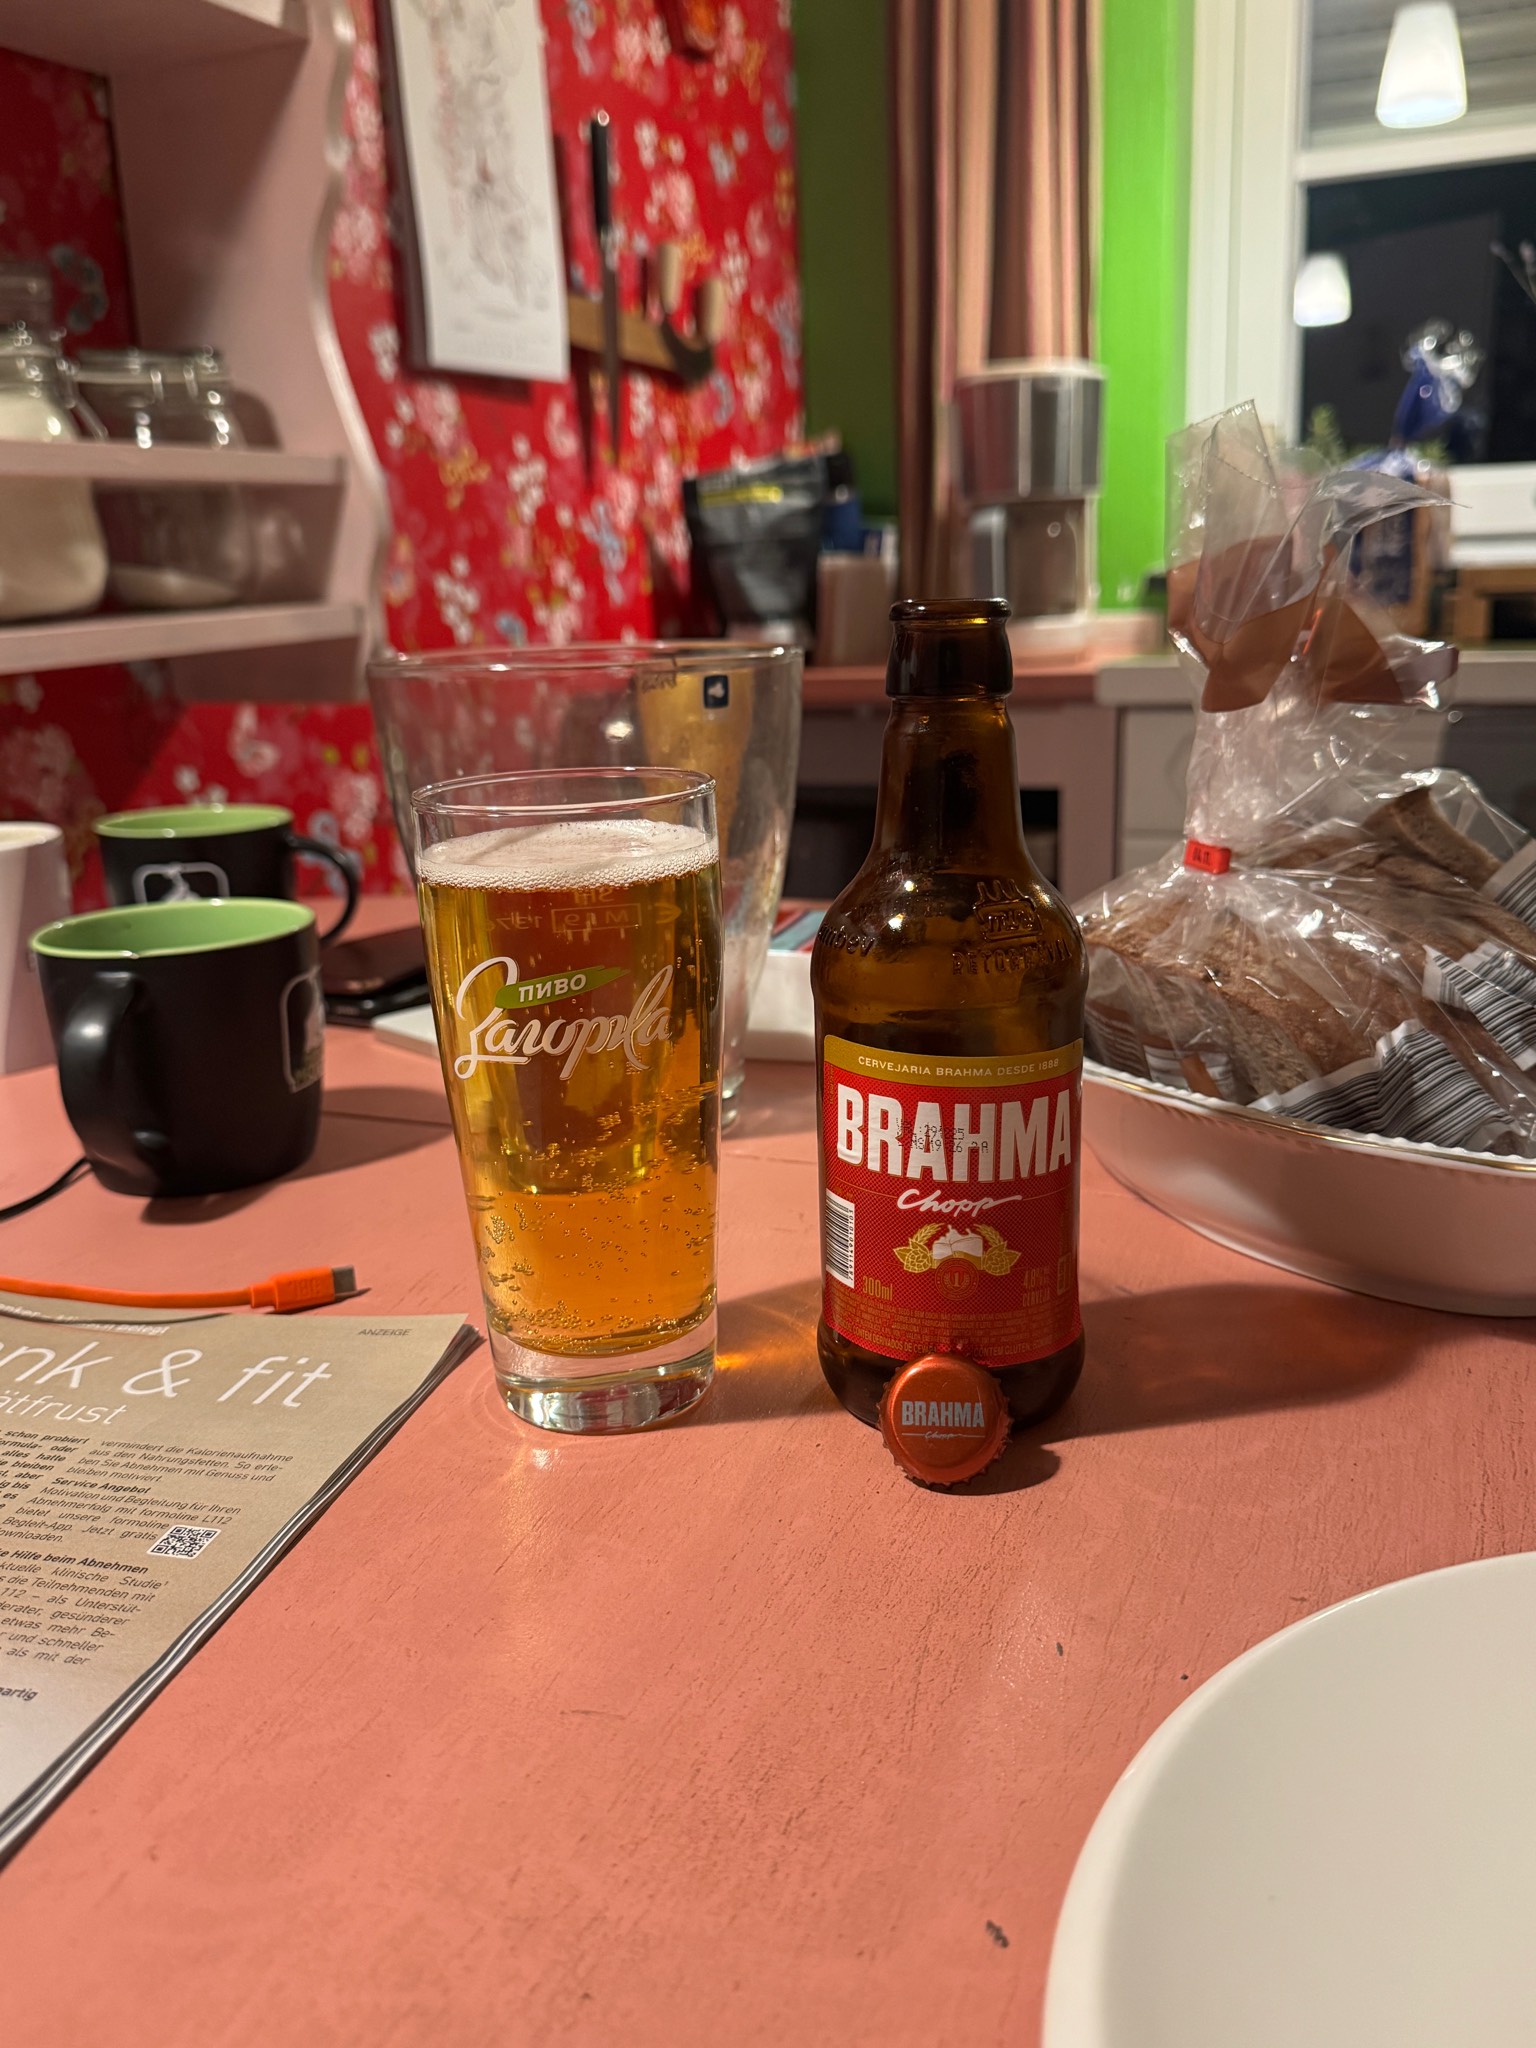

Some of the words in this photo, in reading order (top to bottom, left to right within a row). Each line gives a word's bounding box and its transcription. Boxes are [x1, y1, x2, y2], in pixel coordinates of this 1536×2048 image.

[858, 1056, 931, 1075] CERVEJARIA
[936, 1067, 993, 1077] BRAHMA
[997, 1063, 1035, 1076] DESDE
[1038, 1058, 1060, 1071] 1888
[837, 1083, 1072, 1182] BRAHMA
[897, 1188, 1023, 1217] Chopp
[863, 1275, 894, 1301] 300ml
[358, 1328, 412, 1337] ANZEIGE
[0, 1341, 113, 1389] nk
[121, 1348, 204, 1398] &
[217, 1356, 332, 1408] fit
[902, 1401, 985, 1427] BRAHMA
[4, 1430, 39, 1440] schon
[40, 1434, 90, 1445] probiert
[1, 1450, 31, 1458] alles
[35, 1453, 66, 1462] hatte
[50, 1445, 79, 1453] oder
[101, 1440, 164, 1452] vermindert
[165, 1445, 184, 1454] die
[185, 1447, 294, 1462] Kalorienaufnahme
[11, 1461, 55, 1471] bleiben
[78, 1457, 101, 1466] ben
[101, 1459, 120, 1468] Sie
[120, 1461, 183, 1474] Abnehmen
[184, 1467, 206, 1476] mit
[205, 1469, 249, 1480] Genuss
[250, 1473, 277, 1482] und
[113, 1450, 136, 1459] den
[139, 1452, 230, 1469] Nahrungsfetten.
[234, 1461, 252, 1470] So
[254, 1463, 284, 1472] erle-
[14, 1472, 45, 1480] aber
[66, 1466, 109, 1478] bleiben
[108, 1471, 163, 1483] motiviert.
[11, 1481, 31, 1490] bis
[51, 1477, 98, 1488] Service
[98, 1482, 152, 1495] Angebot
[26, 1497, 112, 1514] Abnehmerfolg
[114, 1506, 137, 1516] mit
[139, 1507, 199, 1522] formoline
[202, 1514, 233, 1525] L112
[40, 1487, 101, 1500] Motivation
[100, 1493, 125, 1503] und
[124, 1495, 188, 1511] Begleitung
[189, 1501, 209, 1511] für
[208, 1503, 241, 1515] Ihren
[2, 1516, 73, 1531] Begleit-App.
[81, 1525, 115, 1536] Jetzt
[119, 1530, 158, 1541] gratis
[15, 1506, 51, 1517] bietet
[58, 1512, 101, 1522] unsere
[109, 1516, 170, 1530] formoline
[10, 1550, 42, 1560] Hilfe
[43, 1553, 76, 1564] beim
[77, 1557, 149, 1575] Abnehmen
[50, 1566, 110, 1583] klinische
[7, 1575, 29, 1585] die
[31, 1576, 129, 1599] Teilnehmenden
[131, 1592, 156, 1602] mit
[47, 1594, 69, 1604] als
[75, 1597, 142, 1613] Unterstüt-
[1, 1617, 42, 1629] etwas
[47, 1623, 86, 1635] mehr
[91, 1627, 116, 1638] Be-
[50, 1609, 131, 1626] gesünderer
[8, 1632, 38, 1643] und
[38, 1637, 105, 1652] schneller
[6, 1646, 29, 1657] als
[34, 1651, 60, 1662] mit
[63, 1653, 91, 1665] der
